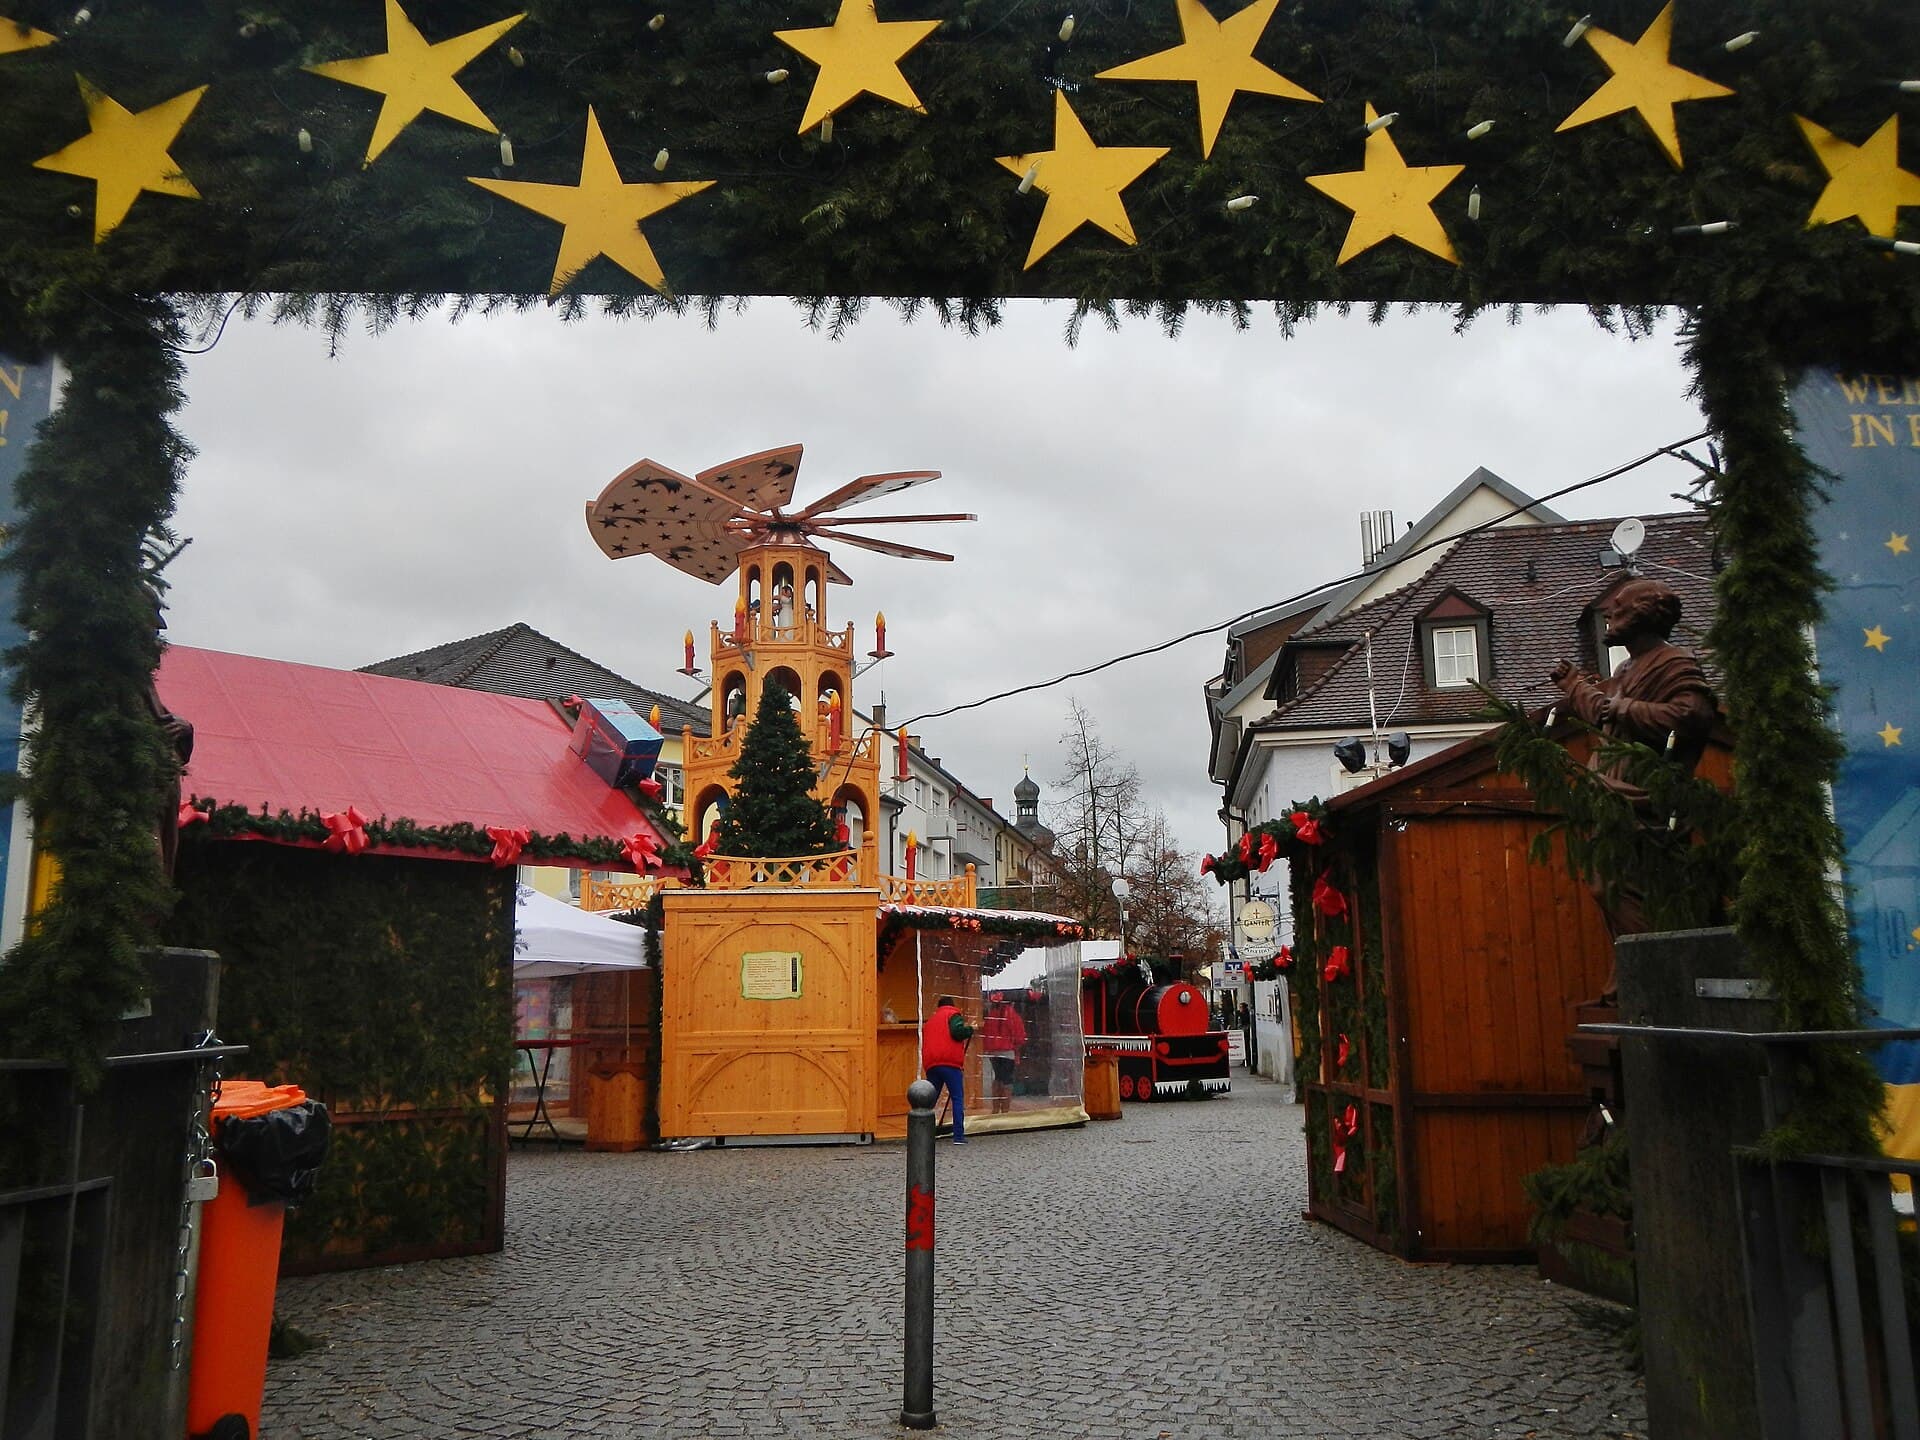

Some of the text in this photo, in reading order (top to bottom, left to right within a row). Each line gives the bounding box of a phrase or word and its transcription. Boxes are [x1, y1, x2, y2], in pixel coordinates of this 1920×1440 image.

[1834, 373, 1920, 405] WEI
[1848, 414, 1896, 448] IN
[1243, 919, 1271, 927] GANTER
